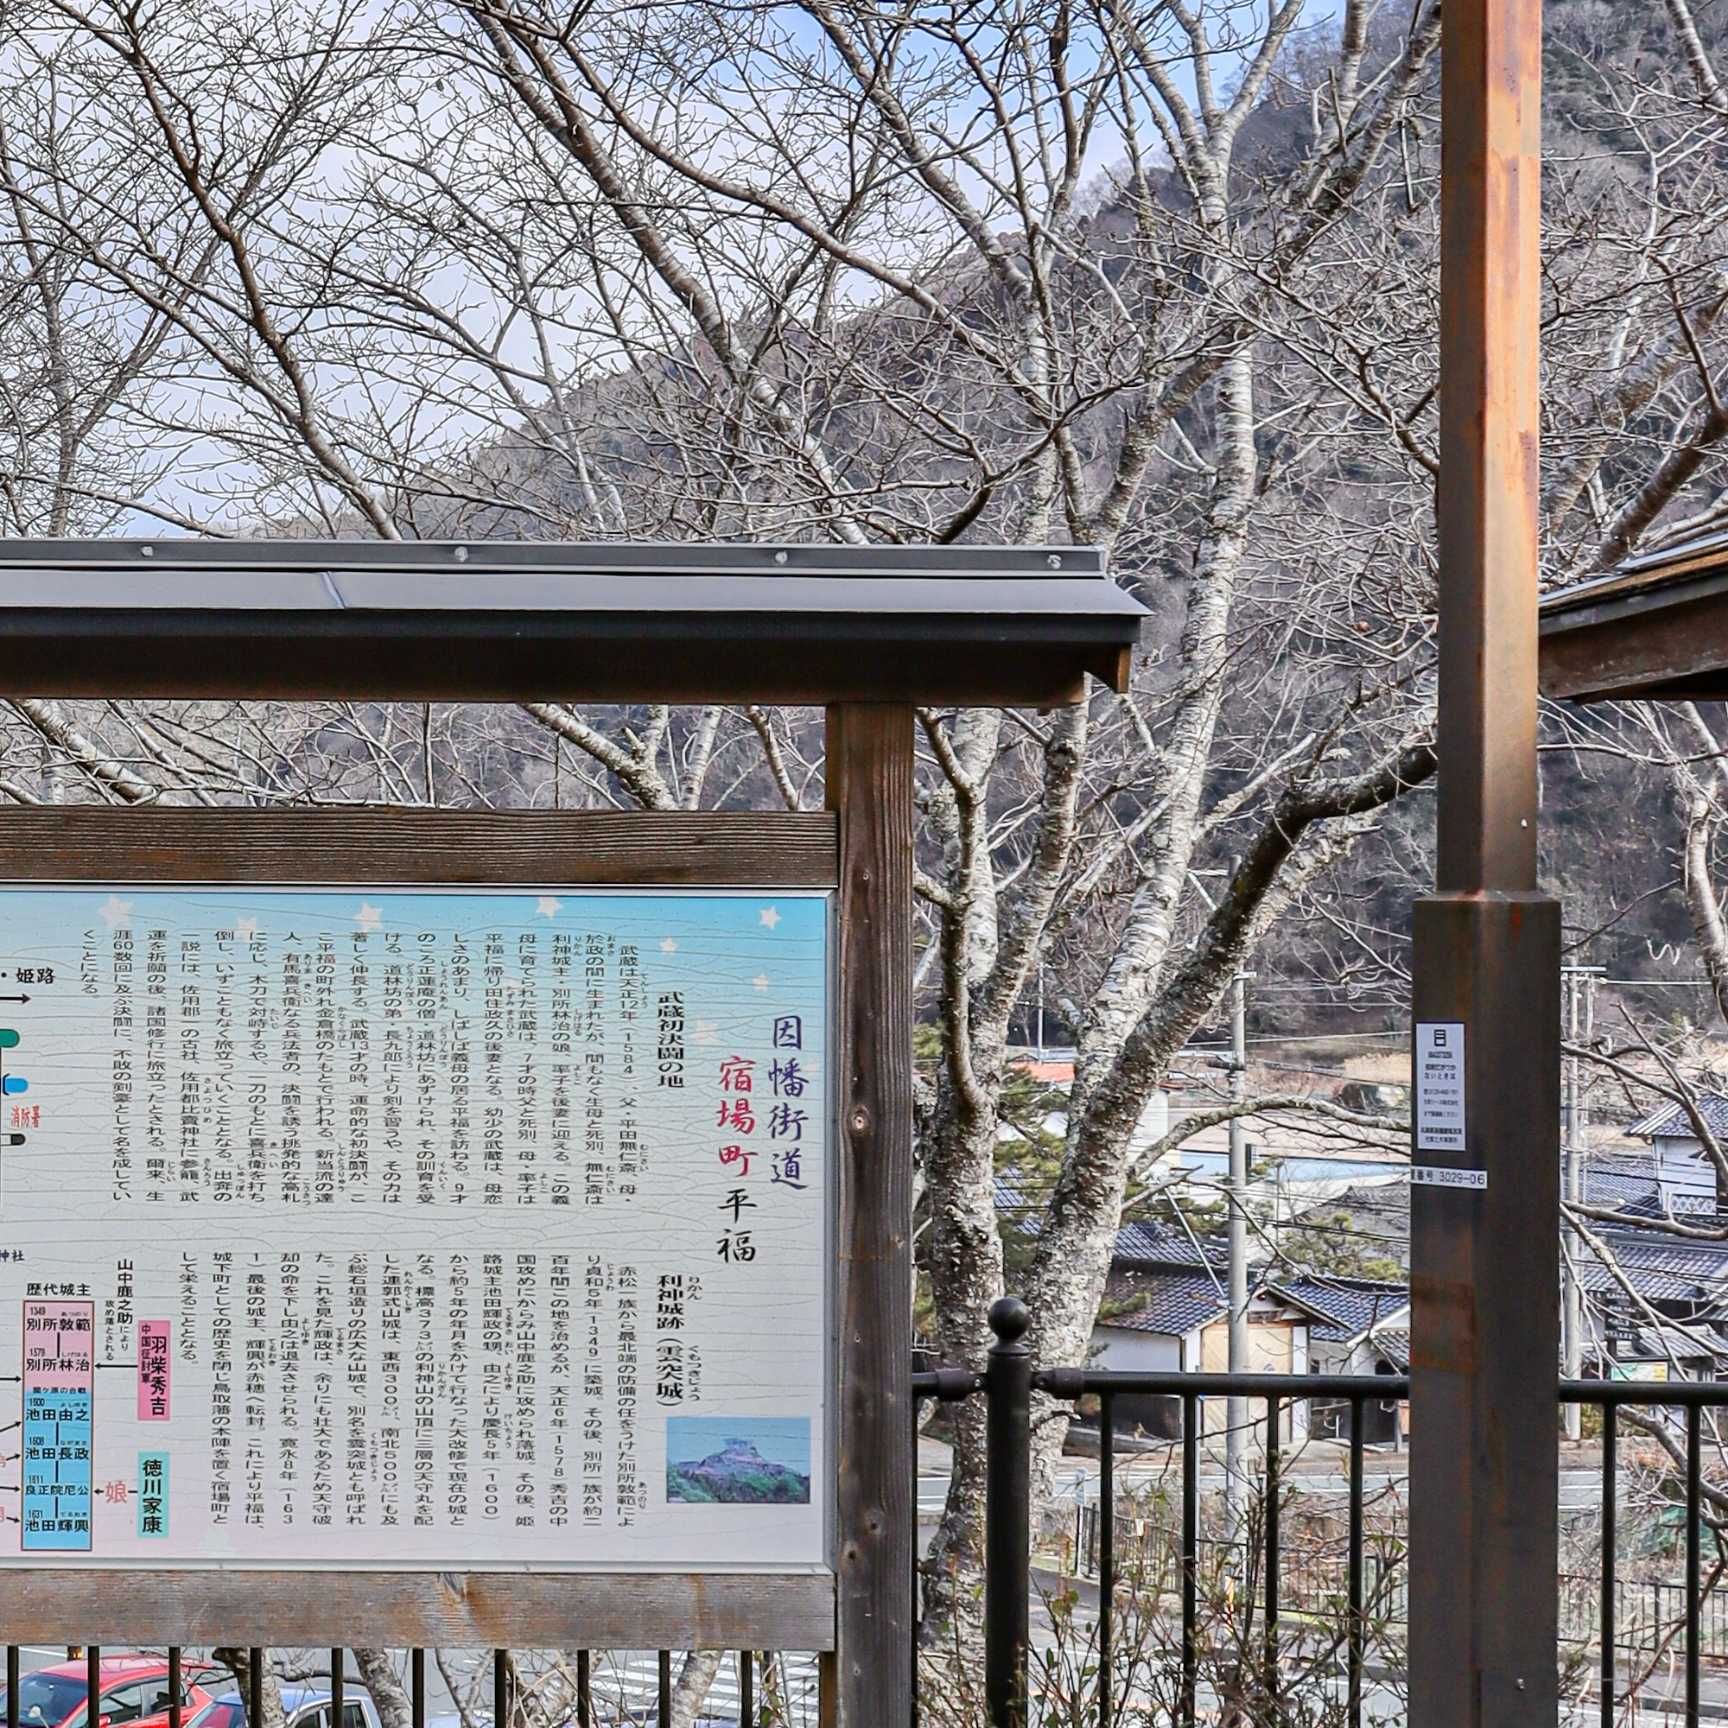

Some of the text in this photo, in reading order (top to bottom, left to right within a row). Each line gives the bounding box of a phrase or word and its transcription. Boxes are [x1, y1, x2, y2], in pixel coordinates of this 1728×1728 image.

[80, 929, 100, 999] くことになる。
[657, 991, 685, 1089] 武蔵初決闘の地
[767, 1015, 809, 1191] 因幡街道
[1440, 1170, 1486, 1185] 3029-06
[26, 1282, 92, 1297] 歴代城主
[26, 1318, 91, 1332] 別所敦範
[26, 1358, 90, 1372] 別所林治
[150, 1335, 167, 1416] 羽柴秀吉
[26, 1408, 90, 1422] 池田由之
[25, 1447, 89, 1460] 池田長政
[105, 1480, 128, 1504] 娘
[141, 1459, 163, 1534] 徳川家康
[25, 1519, 89, 1533] 池田輝興
